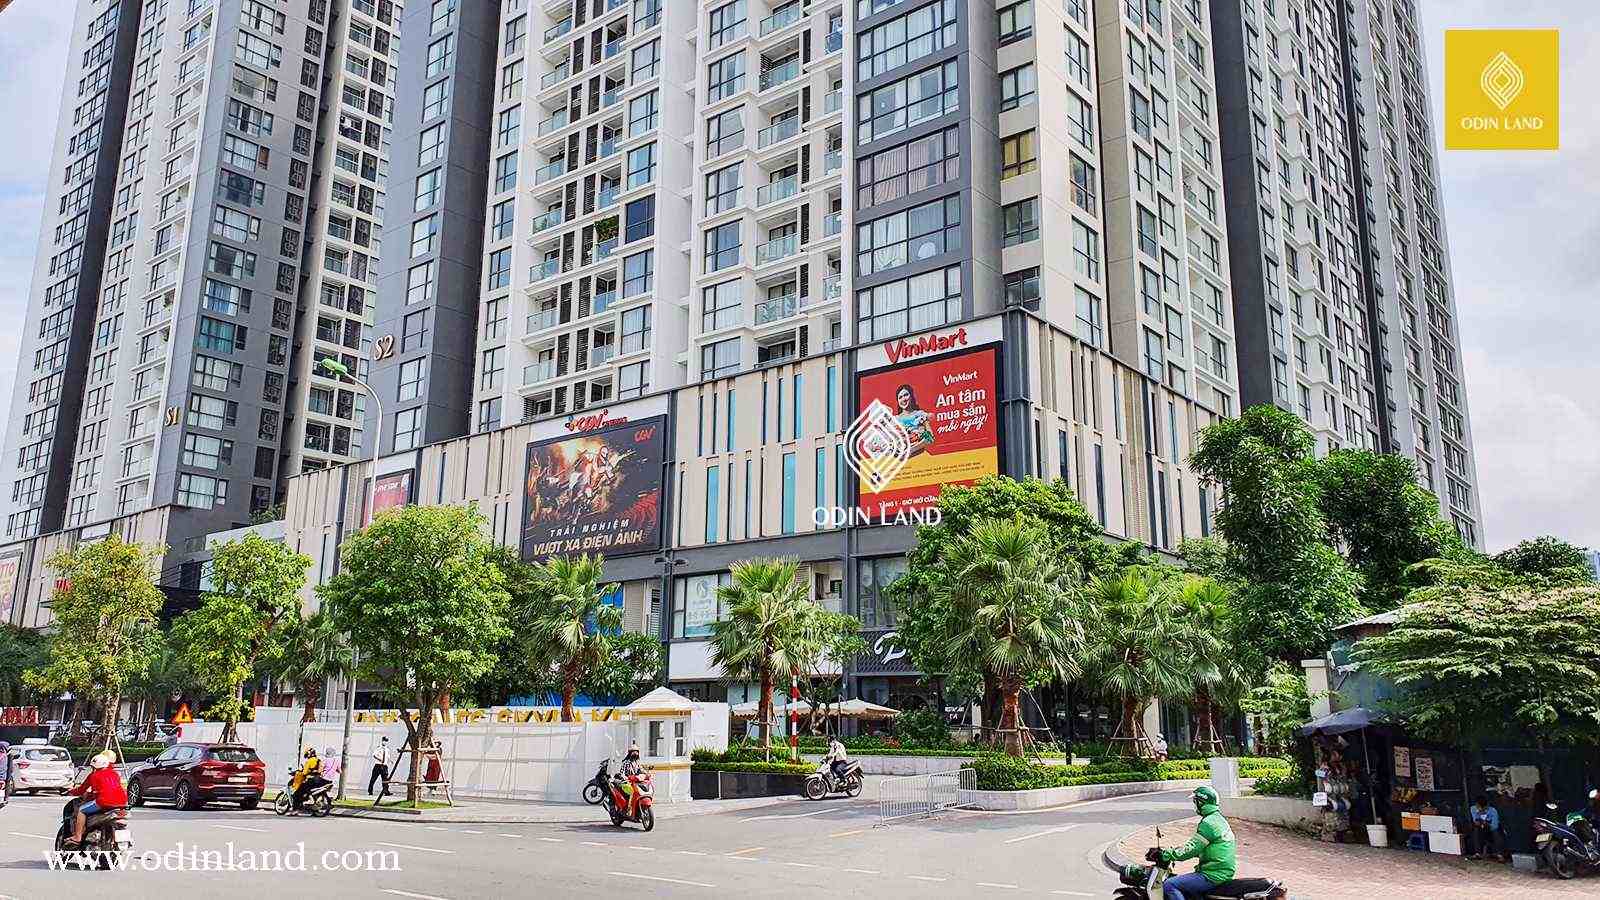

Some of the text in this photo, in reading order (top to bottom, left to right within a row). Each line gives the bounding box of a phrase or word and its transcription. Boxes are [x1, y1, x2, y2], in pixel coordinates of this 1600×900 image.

[374, 335, 395, 361] S2
[884, 327, 968, 363] VinMart
[943, 371, 977, 386] VinMart
[936, 388, 986, 408] An tâm
[165, 406, 180, 427] S1
[937, 402, 986, 421] mua sắm
[634, 427, 655, 442] CGV
[550, 518, 630, 538] TRẢI NGHIỆM
[564, 540, 581, 552] XA
[581, 532, 613, 551] ĐIỆN
[614, 528, 645, 545] ẢNH
